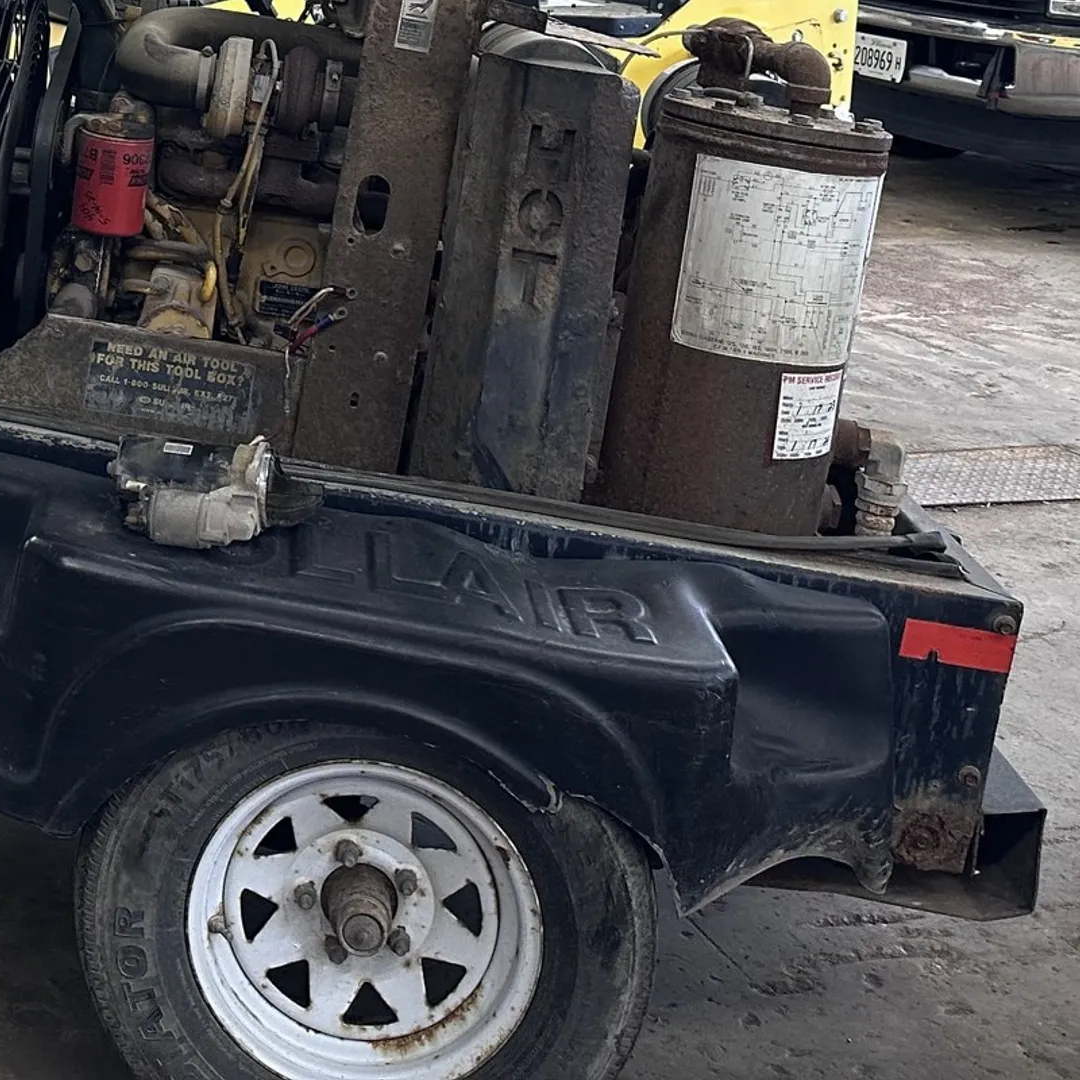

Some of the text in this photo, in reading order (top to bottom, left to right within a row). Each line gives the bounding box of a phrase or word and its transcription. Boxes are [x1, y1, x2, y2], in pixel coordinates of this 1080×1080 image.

[854, 45, 902, 71] 208969 H
[96, 353, 245, 387] FOR THIS TOOL BOX?
[107, 341, 238, 373] NEED AN AIR TOOL
[99, 374, 120, 385] CALL
[783, 375, 796, 384] PM
[797, 375, 824, 385] SERVICE
